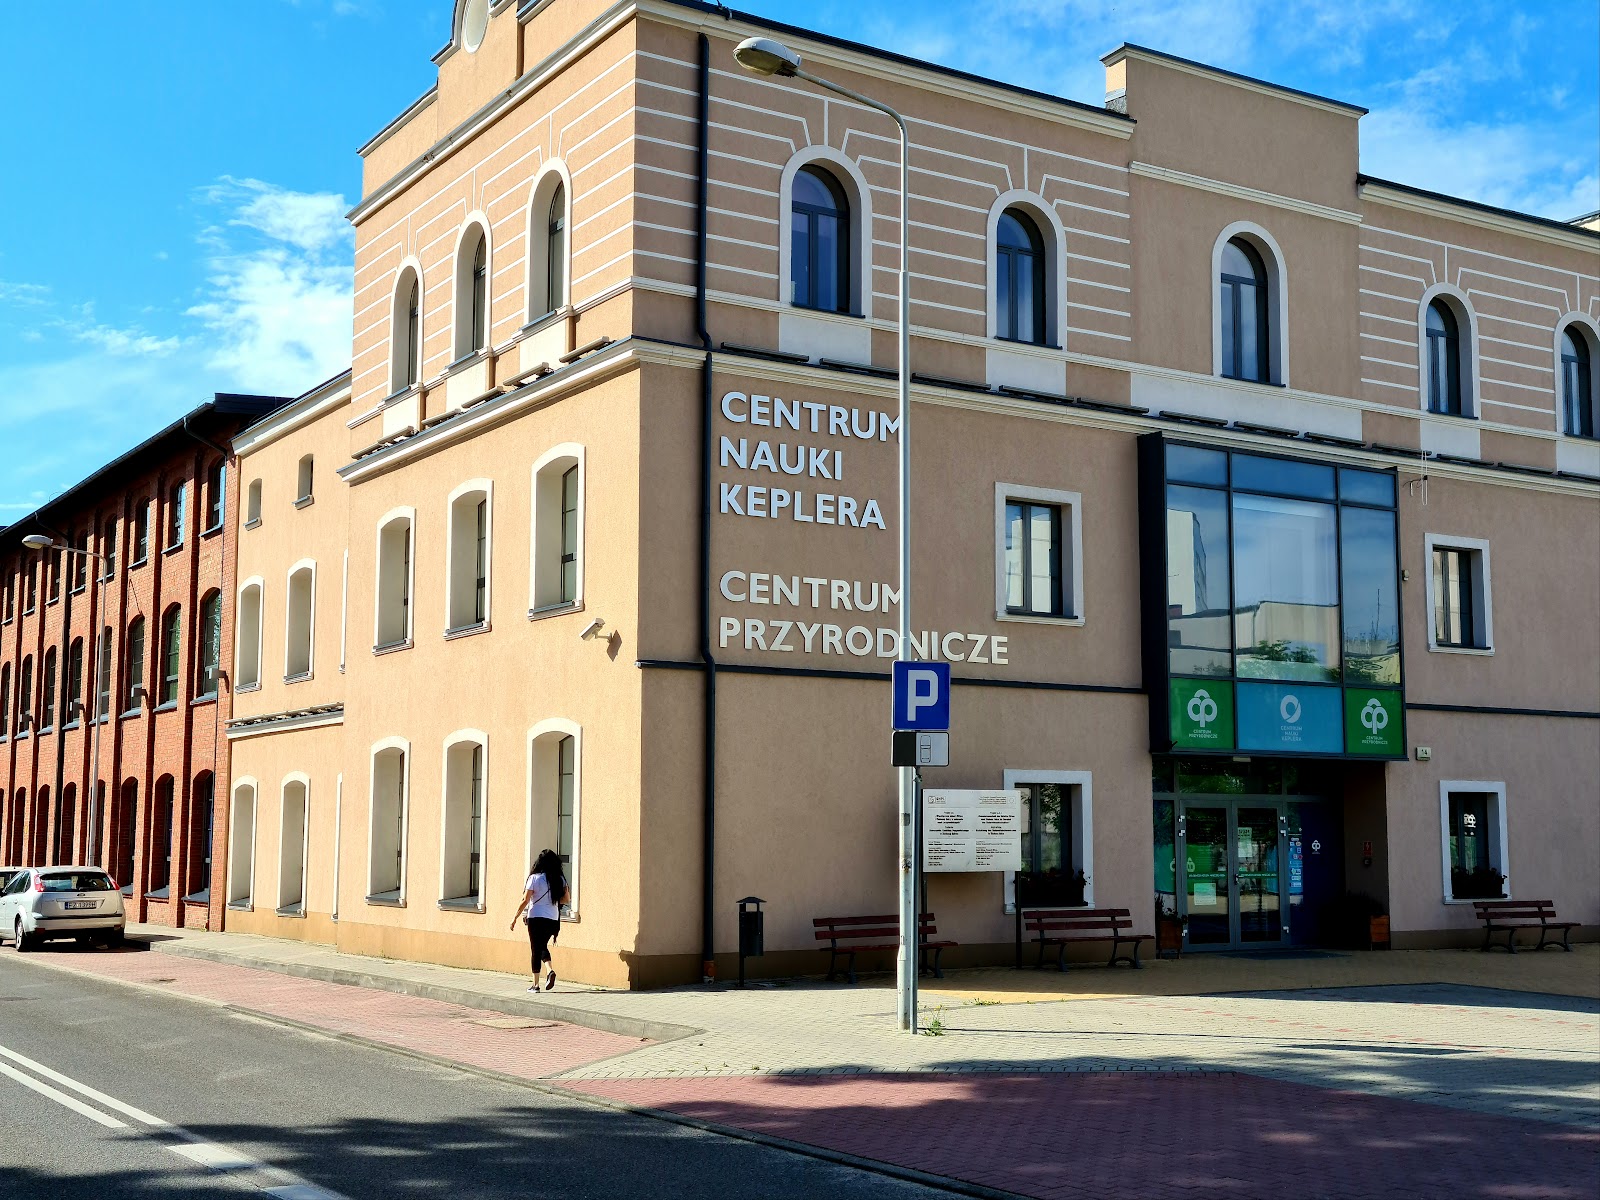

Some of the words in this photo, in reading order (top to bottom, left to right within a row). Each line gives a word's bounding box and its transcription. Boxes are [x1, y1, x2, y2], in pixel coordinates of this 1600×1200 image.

[721, 391, 900, 442] CENTRUM
[720, 436, 843, 480] NAUKI
[720, 483, 886, 530] KEPLERA
[719, 570, 900, 613] CENTRUM
[719, 616, 1009, 665] PRZYRODNICZE
[907, 669, 939, 722] P
